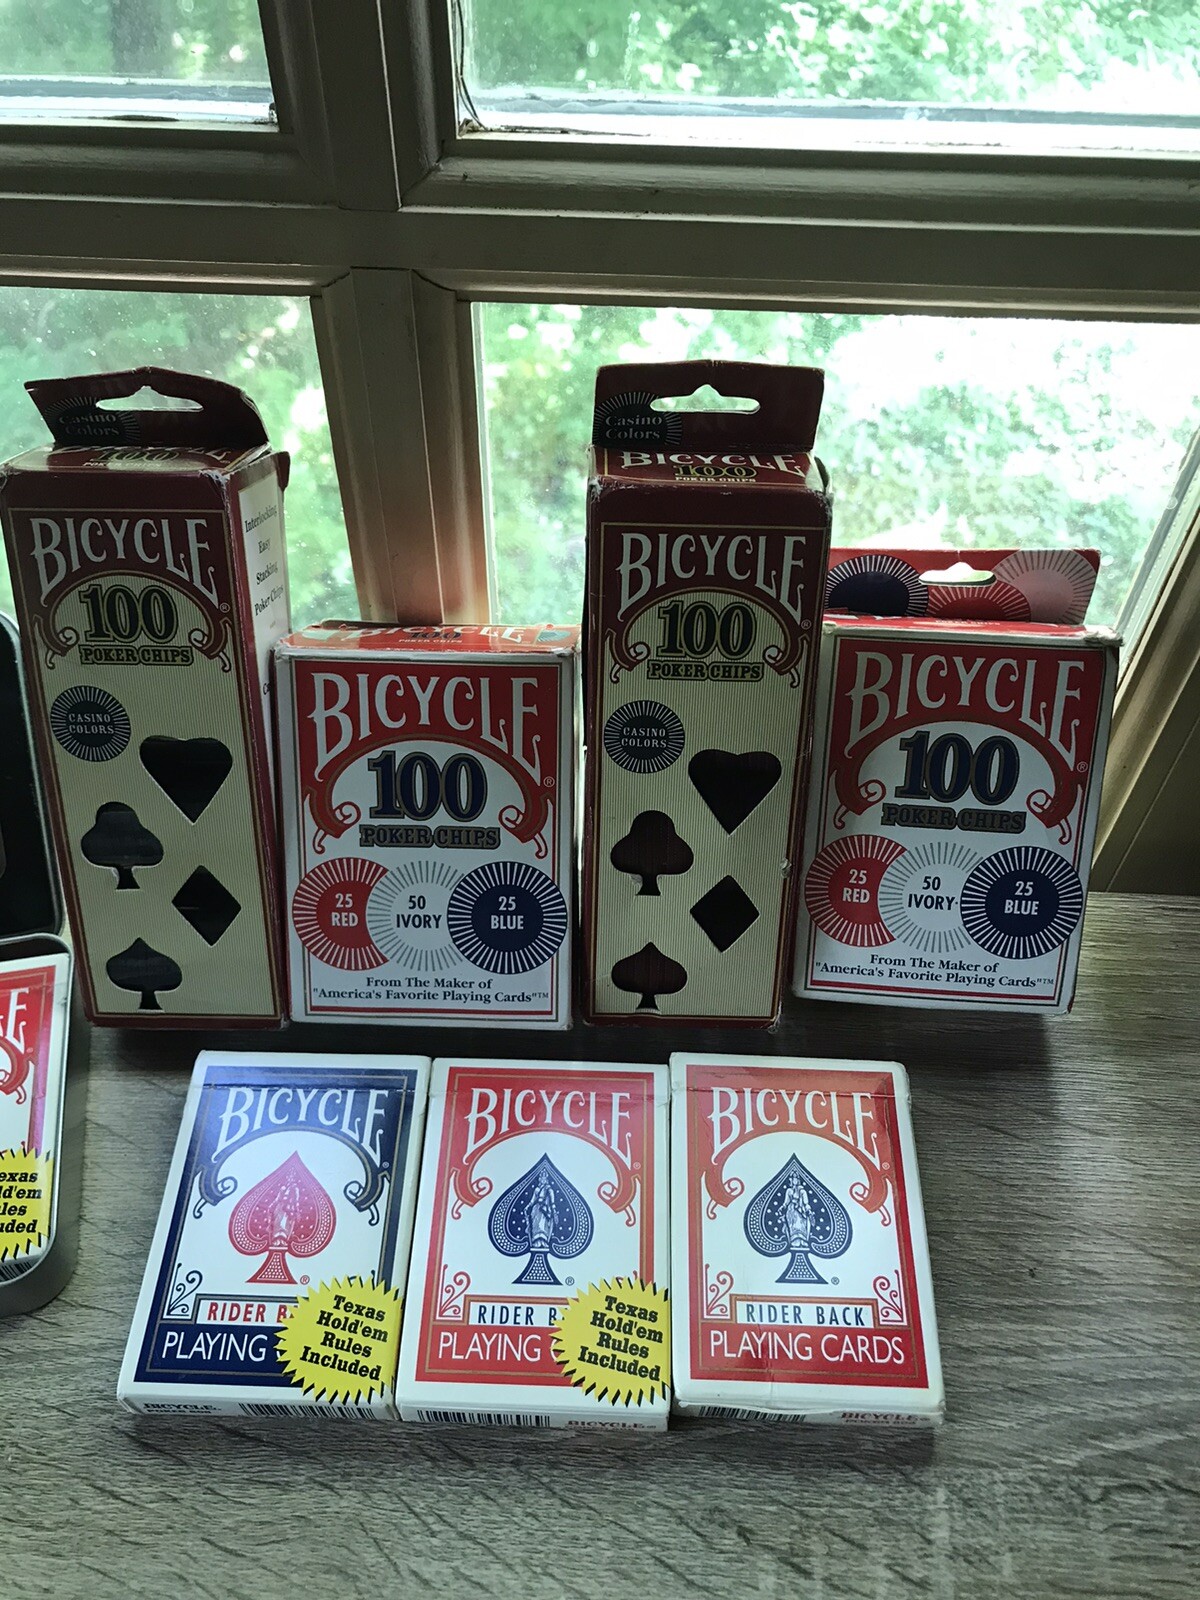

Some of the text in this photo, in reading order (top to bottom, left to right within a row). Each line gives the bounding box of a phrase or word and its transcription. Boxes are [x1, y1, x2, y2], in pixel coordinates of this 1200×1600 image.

[59, 412, 117, 425] Casino
[605, 414, 663, 427] Casino
[65, 423, 120, 436] Colors
[605, 427, 660, 440] Colors
[620, 451, 806, 478] BICYCLE
[673, 465, 757, 478] 100
[244, 505, 278, 532] Interlocking
[258, 539, 271, 554] Easy
[28, 517, 220, 609] BICYCLE
[256, 561, 278, 585] Stacking
[615, 531, 807, 626] BICYCLE
[255, 584, 284, 616] Poker Chips
[79, 584, 179, 645] 100
[656, 600, 757, 660] 100
[81, 647, 191, 664] POKER CHIPS
[648, 661, 763, 680] POKER CHIPS
[68, 713, 111, 723] CASINO
[844, 650, 1085, 772] BICYCLE
[68, 724, 115, 734] COLORS
[307, 671, 541, 786] BICYCLE
[623, 727, 666, 737] CASINO
[621, 738, 667, 748] COLORS
[894, 730, 1020, 806] 100
[367, 750, 488, 822] 100
[884, 805, 1026, 832] POKER CHIPS
[361, 827, 500, 848] POKER CHIPS
[849, 869, 868, 885] 25
[922, 875, 941, 891] 50
[842, 887, 870, 904] RED
[1015, 880, 1034, 897] 25
[335, 893, 353, 908] 25
[408, 895, 426, 910] 50
[498, 896, 516, 911] 25
[908, 894, 956, 911] IVORY
[1004, 899, 1040, 916] BLUE
[331, 912, 359, 927] RED
[396, 913, 442, 929] IVORY
[490, 914, 524, 930] BLUE
[870, 954, 1000, 973] From The Maker of
[366, 977, 494, 989] From The Maker of
[888, 968, 942, 982] Favorite
[946, 973, 995, 987] Playing
[386, 989, 439, 1000] Favorite
[442, 990, 491, 1004] Playing
[211, 1086, 388, 1165] BICYCLE
[462, 1087, 632, 1171] BICYCLE
[707, 1086, 882, 1172] BICYCLE
[0, 1171, 38, 1183] exas
[0, 1202, 28, 1216] les
[207, 1302, 265, 1323] RIDER
[333, 1294, 386, 1322] Texas
[477, 1304, 535, 1326] RIDER
[604, 1295, 658, 1323] Texas
[745, 1303, 866, 1327] RIDER BACK
[316, 1310, 389, 1343] Hold'em
[590, 1310, 663, 1344] Hold'em
[161, 1330, 268, 1362] PLAYING
[320, 1331, 372, 1358] Rules
[438, 1331, 542, 1363] PLAYING
[596, 1331, 649, 1358] Rules
[710, 1329, 905, 1365] PLAYING CARDS
[300, 1345, 382, 1381] Included
[577, 1345, 661, 1382] Included
